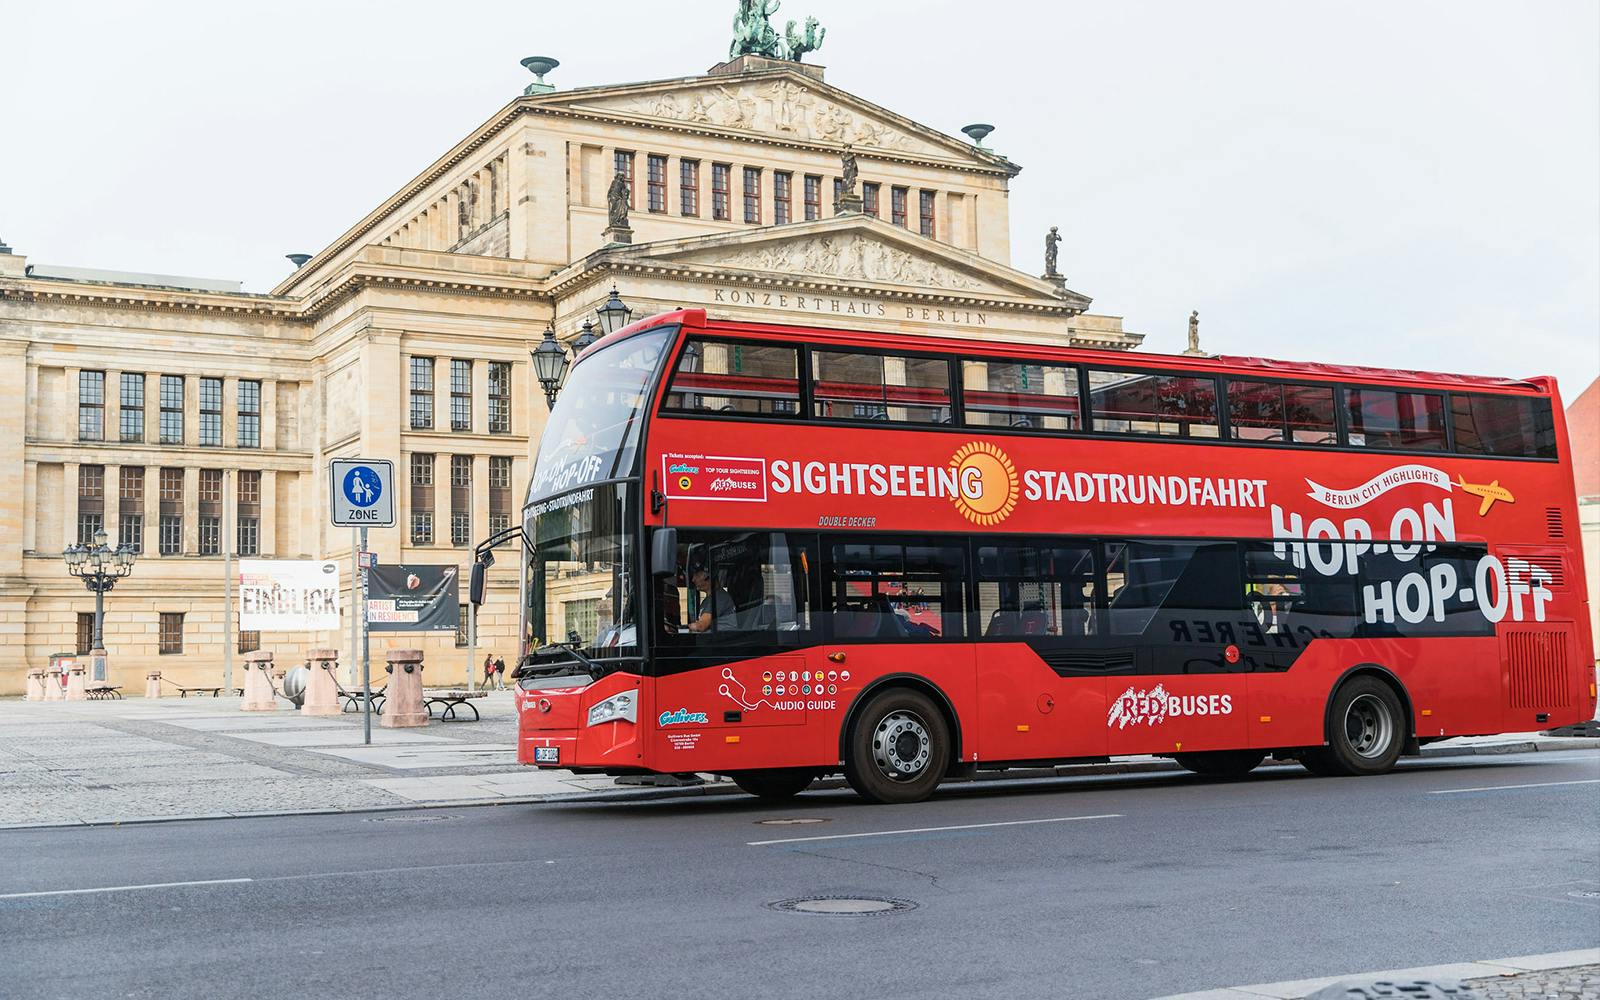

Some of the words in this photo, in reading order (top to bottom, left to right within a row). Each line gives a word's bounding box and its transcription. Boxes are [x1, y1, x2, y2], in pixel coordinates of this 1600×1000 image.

[714, 288, 885, 316] KONZERTHAUS
[906, 307, 988, 325] BERLIN
[552, 455, 602, 492] HOP-OFF
[770, 460, 983, 500] SIGHTSEEING
[1023, 470, 1268, 508] STADTRUNDFAHRT
[1325, 491, 1360, 506] BERLIN
[1362, 484, 1382, 499] CITY
[1382, 470, 1439, 486] HIGHLIGHTS
[349, 509, 378, 520] ZONE
[818, 515, 847, 527] DOUBLE
[848, 516, 877, 528] DECKER
[1271, 498, 1456, 576] HOP-ON
[1363, 555, 1553, 624] HOP-OFF
[369, 601, 392, 611] ARTIST
[369, 612, 377, 621] IN
[377, 612, 417, 621] RESIDENCE
[774, 701, 804, 711] AUDIO
[807, 700, 836, 710] GUIDE
[1168, 694, 1233, 717] BUSES
